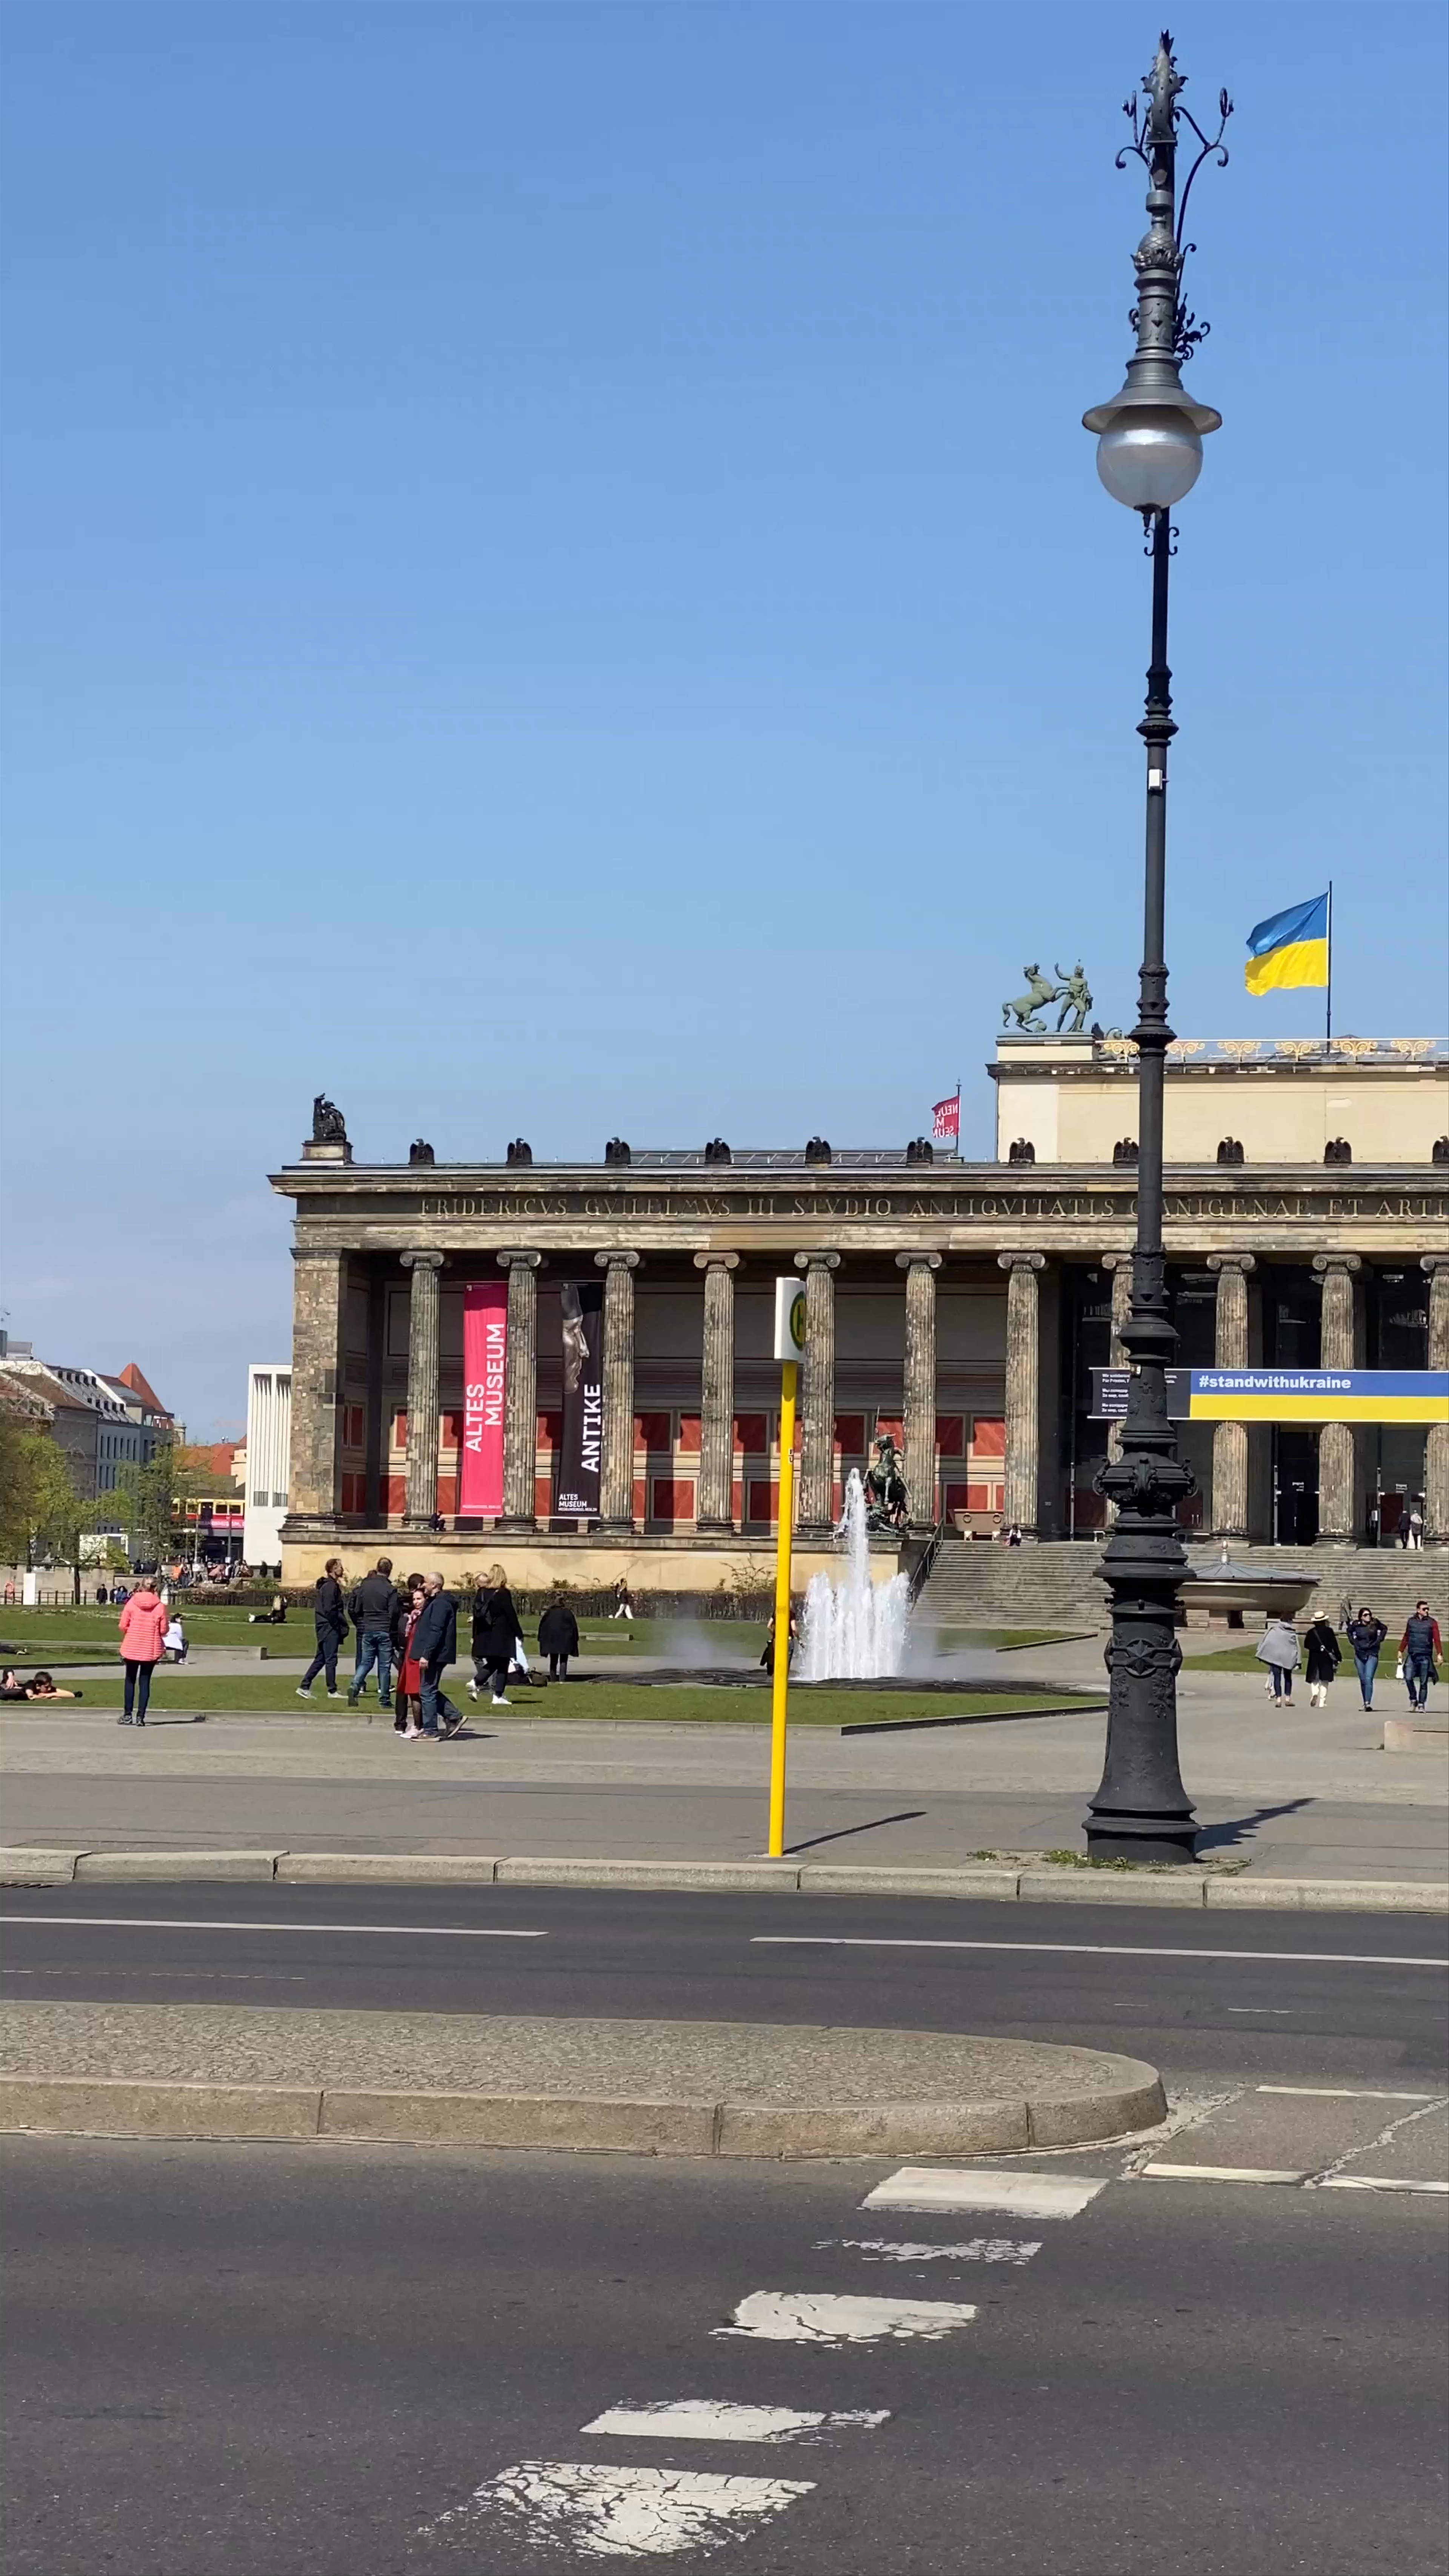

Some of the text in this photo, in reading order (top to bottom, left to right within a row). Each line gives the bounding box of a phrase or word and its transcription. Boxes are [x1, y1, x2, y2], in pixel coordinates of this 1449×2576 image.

[420, 1198, 566, 1216] FRIDERICVS
[585, 1198, 730, 1216] GVILELMVS
[747, 1198, 775, 1216] III
[792, 1198, 891, 1217] STVDIO
[909, 1198, 1114, 1217] ANTIQVITATIS
[1329, 1199, 1363, 1218] ET
[1376, 1199, 1448, 1218] ARTI
[485, 1324, 505, 1426] MUSEUM
[1199, 1375, 1351, 1389] #standwithukraine
[465, 1384, 485, 1452] ALTES
[581, 1384, 601, 1472] ANTIKE
